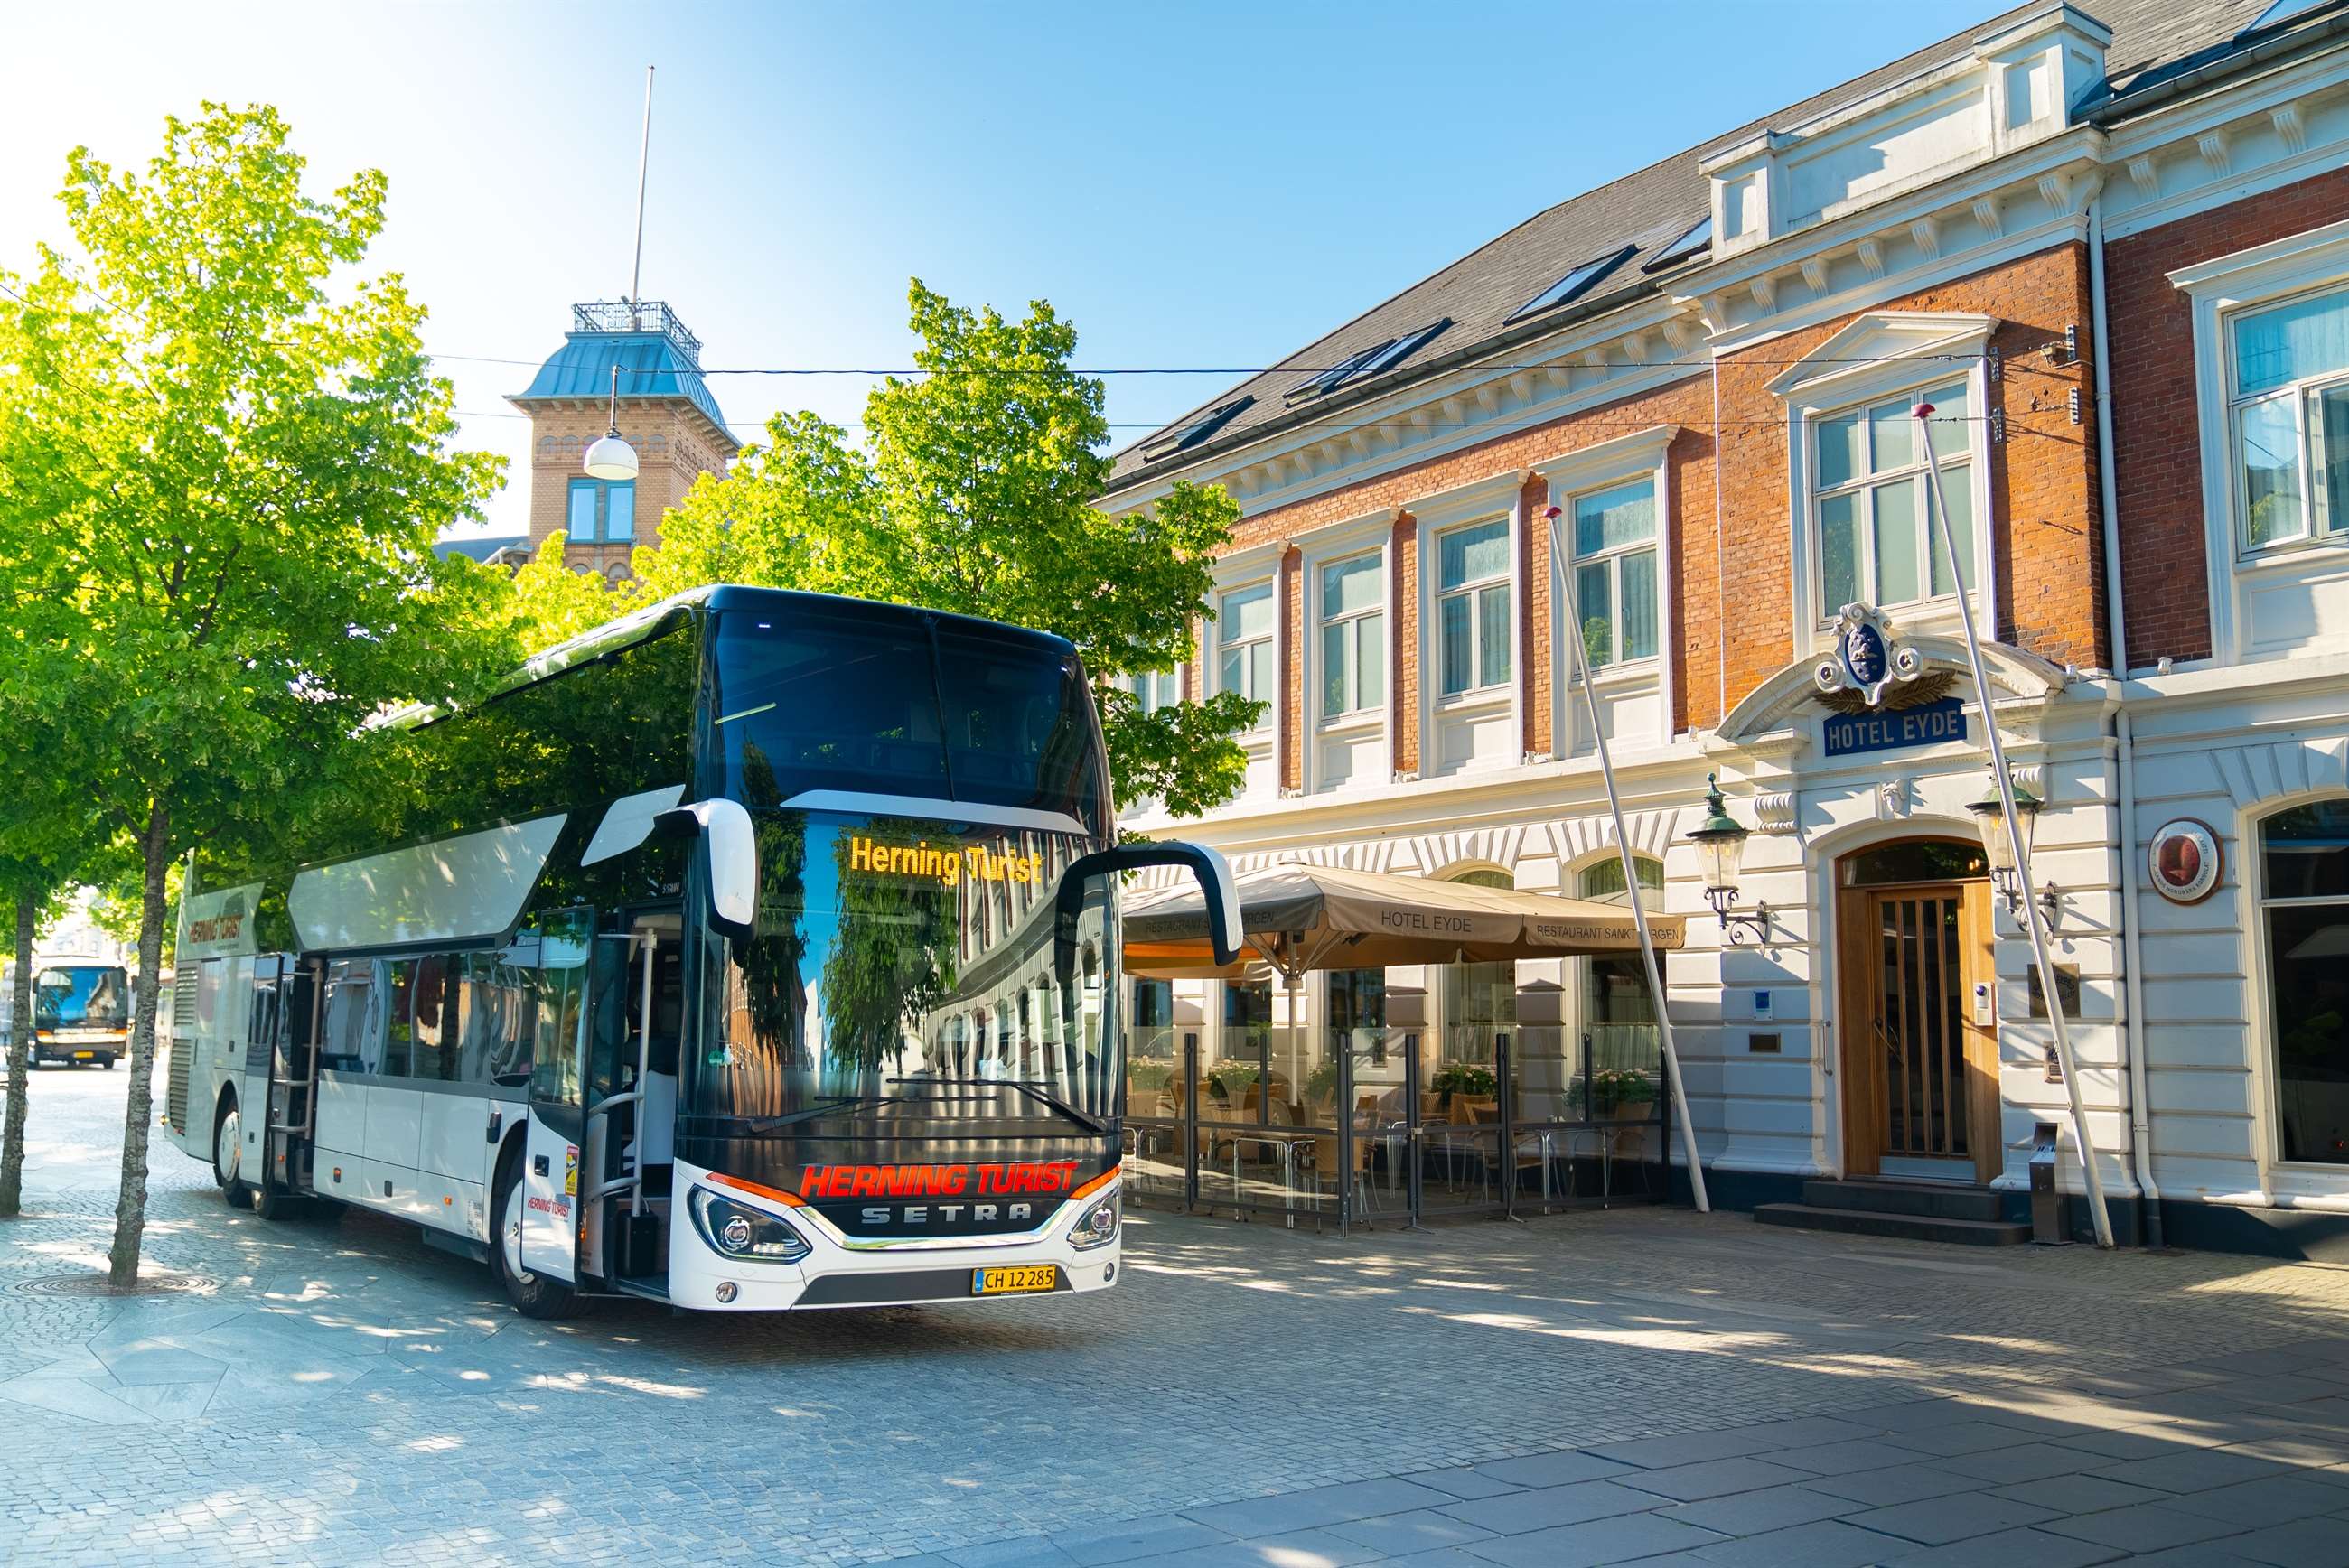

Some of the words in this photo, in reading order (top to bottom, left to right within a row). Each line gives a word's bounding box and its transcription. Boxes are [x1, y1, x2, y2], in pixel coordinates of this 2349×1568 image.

[1829, 720, 1895, 750] HOTEL
[1903, 710, 1959, 740] EYDE
[851, 837, 959, 886] Herning
[968, 847, 1043, 883] Turist
[1381, 910, 1430, 929] HOTEL
[1433, 915, 1472, 933] EYDE
[1537, 924, 1602, 939] RESTAURANT
[1604, 928, 1637, 939] SANKT
[1649, 929, 1679, 939] RGEN
[800, 1165, 968, 1198] HERNING
[977, 1161, 1080, 1194] TURIST
[861, 1202, 1032, 1224] SETRA
[985, 1272, 1005, 1289] CH
[1009, 1272, 1025, 1287] 12
[1028, 1269, 1053, 1286] 285
